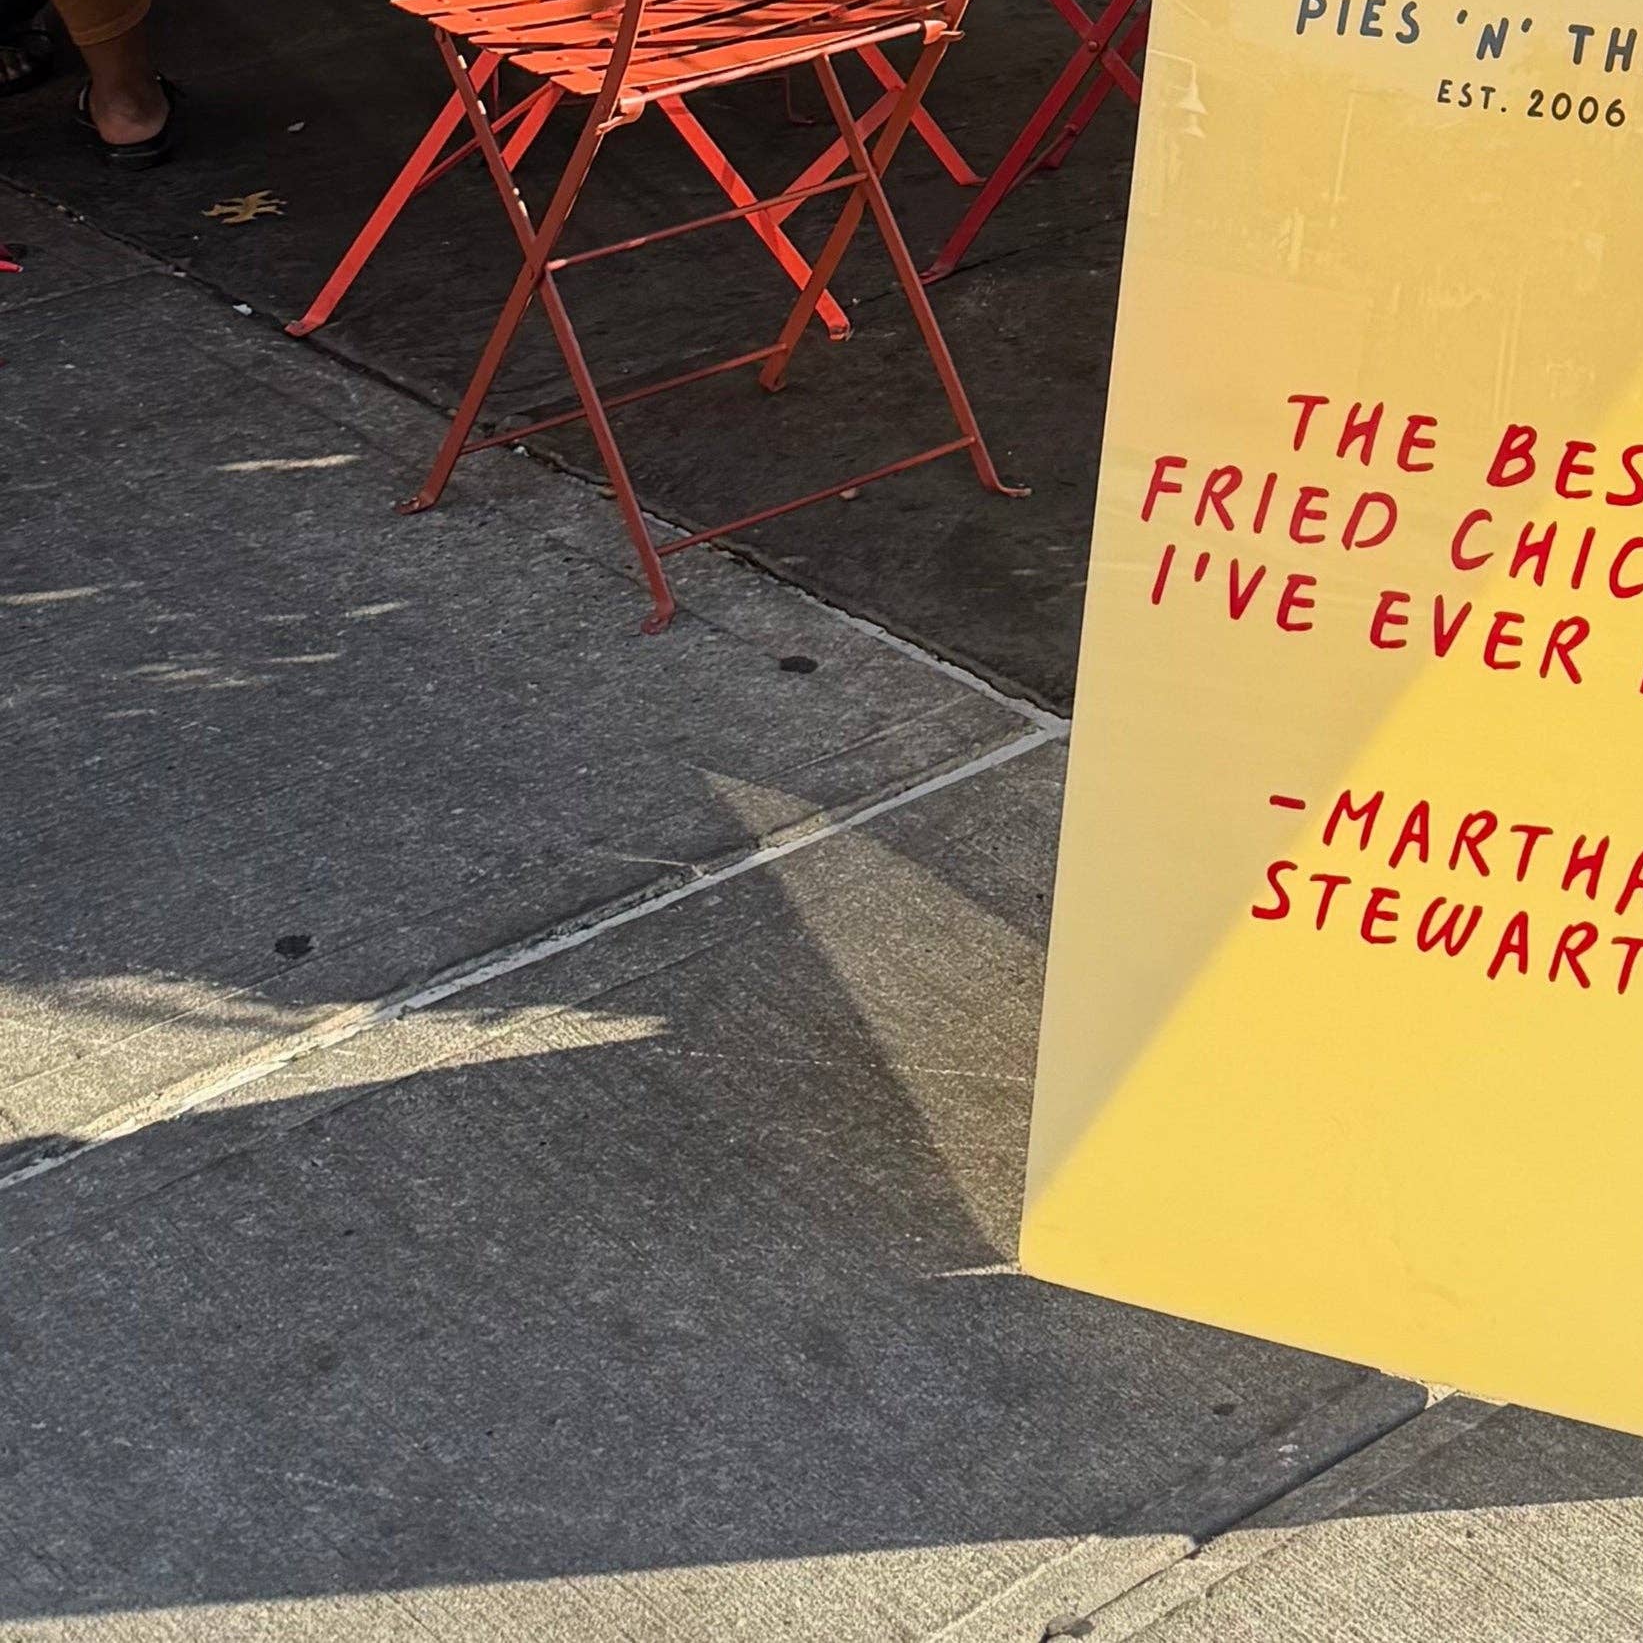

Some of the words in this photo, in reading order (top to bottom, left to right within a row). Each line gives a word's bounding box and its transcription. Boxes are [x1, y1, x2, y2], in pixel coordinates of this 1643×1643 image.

[1436, 79, 1508, 114] EST.
[1526, 88, 1626, 128] 2006
[1286, 393, 1439, 473] THE
[1140, 455, 1398, 551] FRIED
[1151, 544, 1317, 632] I'VE
[1369, 589, 1591, 685] EVER
